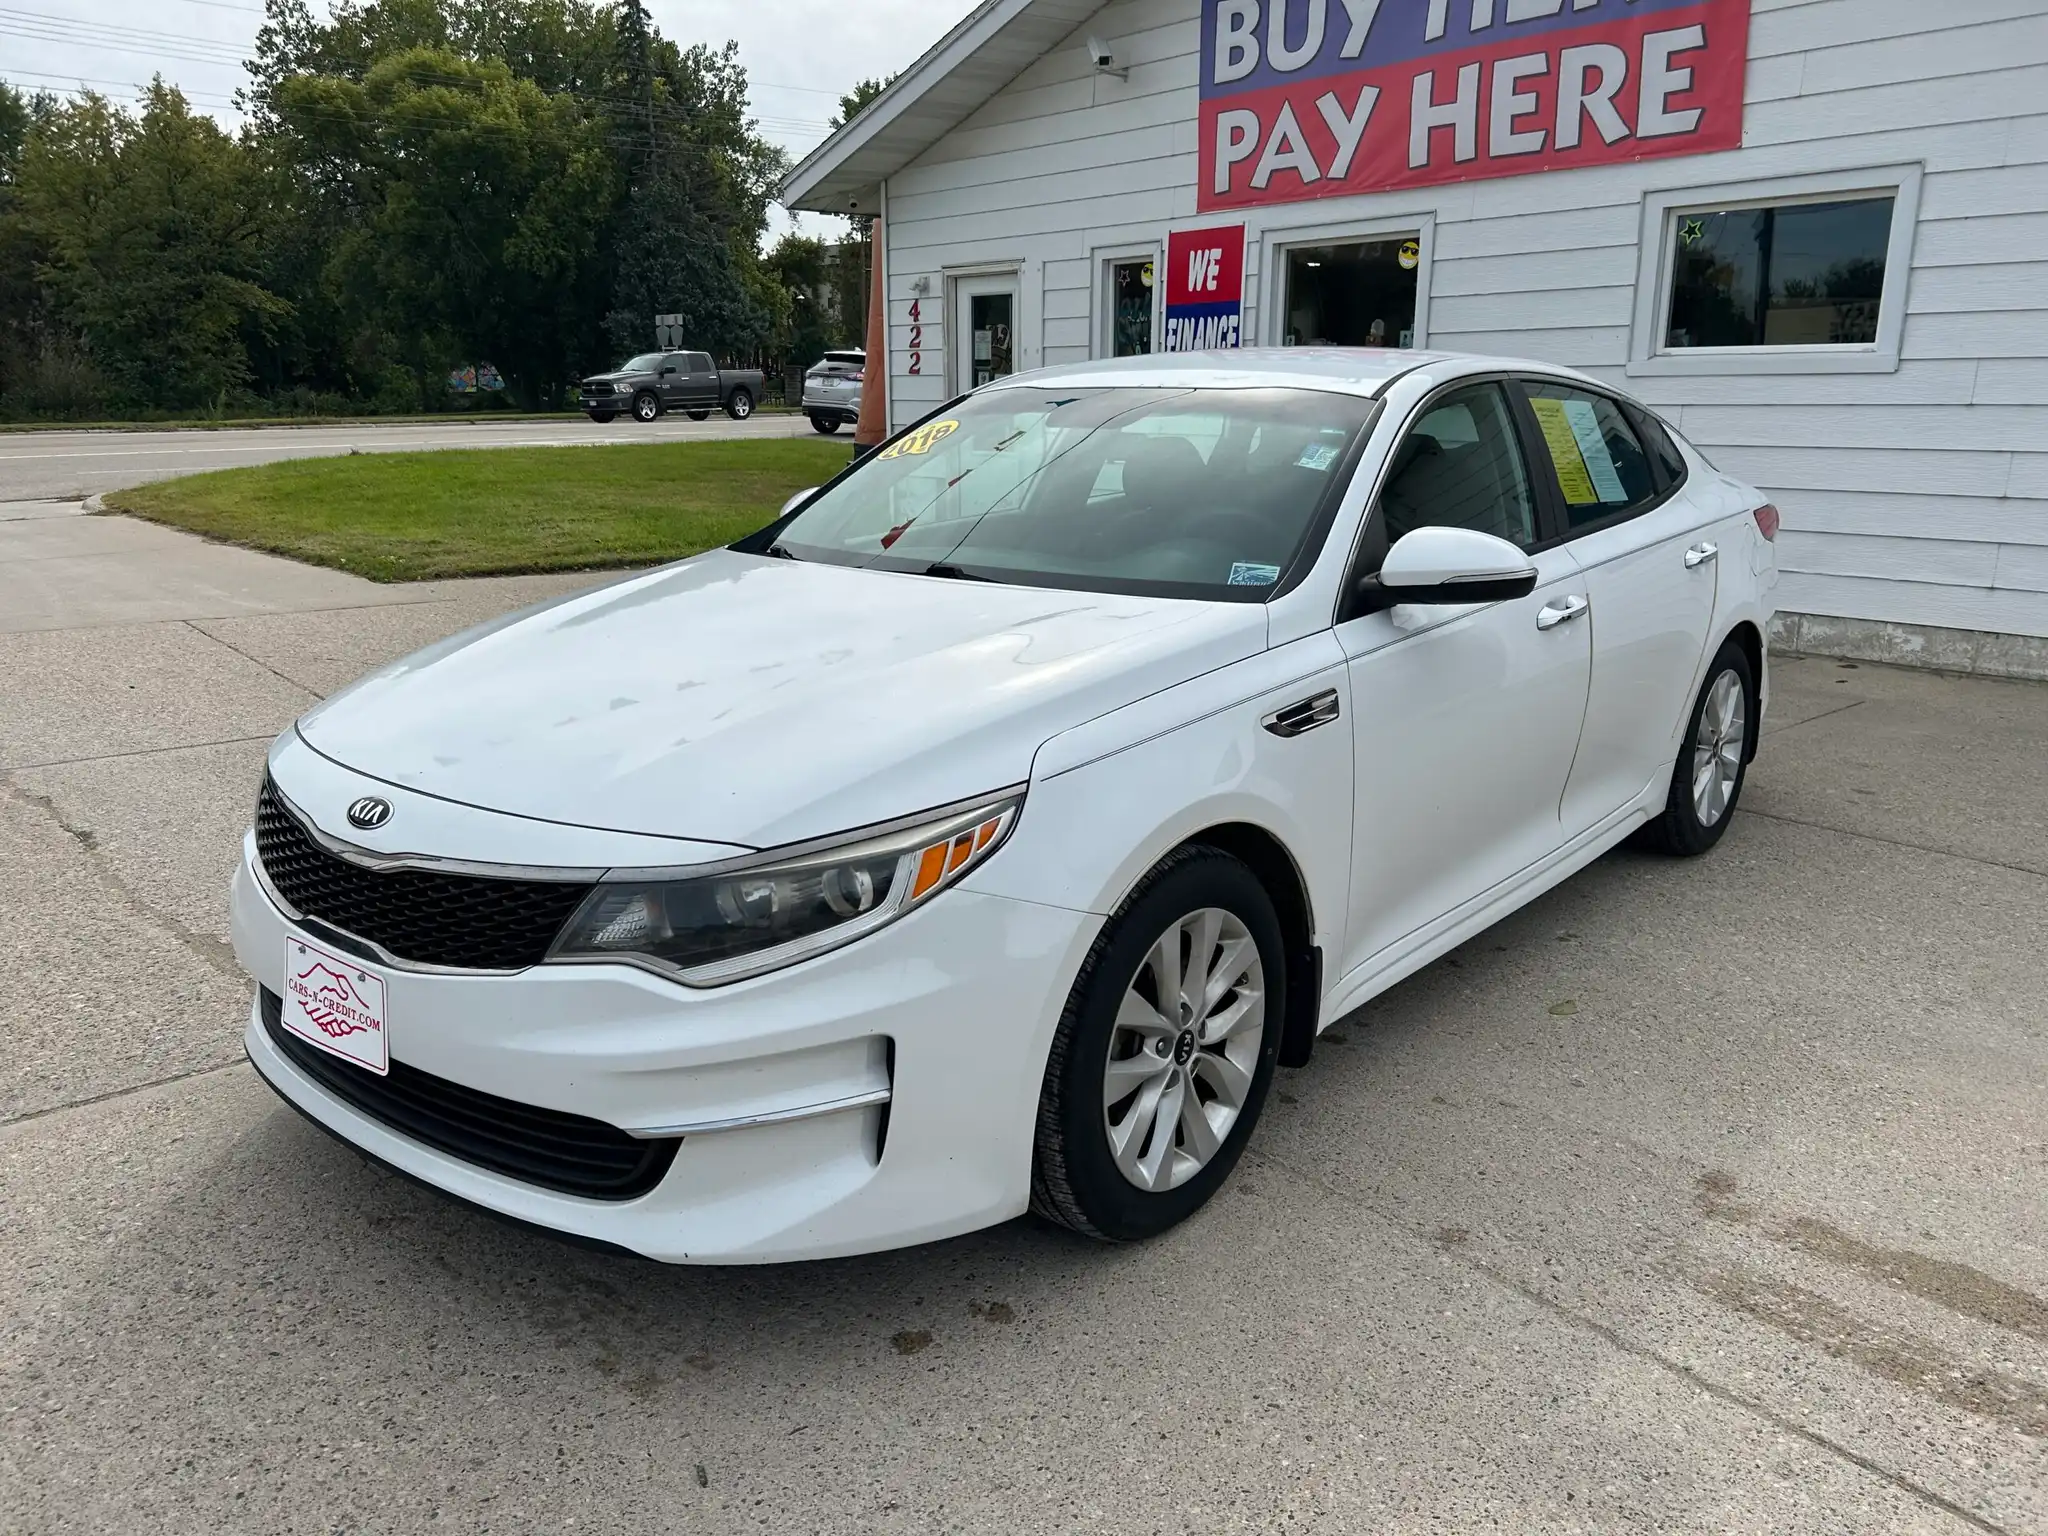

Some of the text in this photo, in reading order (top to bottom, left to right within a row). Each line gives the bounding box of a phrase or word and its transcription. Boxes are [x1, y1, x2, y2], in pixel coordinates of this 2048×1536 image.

[1213, 0, 1379, 84] BUY
[1213, 24, 1706, 194] PAY HERE
[1188, 248, 1222, 292] WE
[1167, 314, 1239, 352] FINANCE
[881, 424, 953, 459] 2018
[350, 799, 384, 824] KIA
[288, 978, 381, 1032] CARS-N-CREDIT.COM
[1180, 1034, 1192, 1062] KIA
